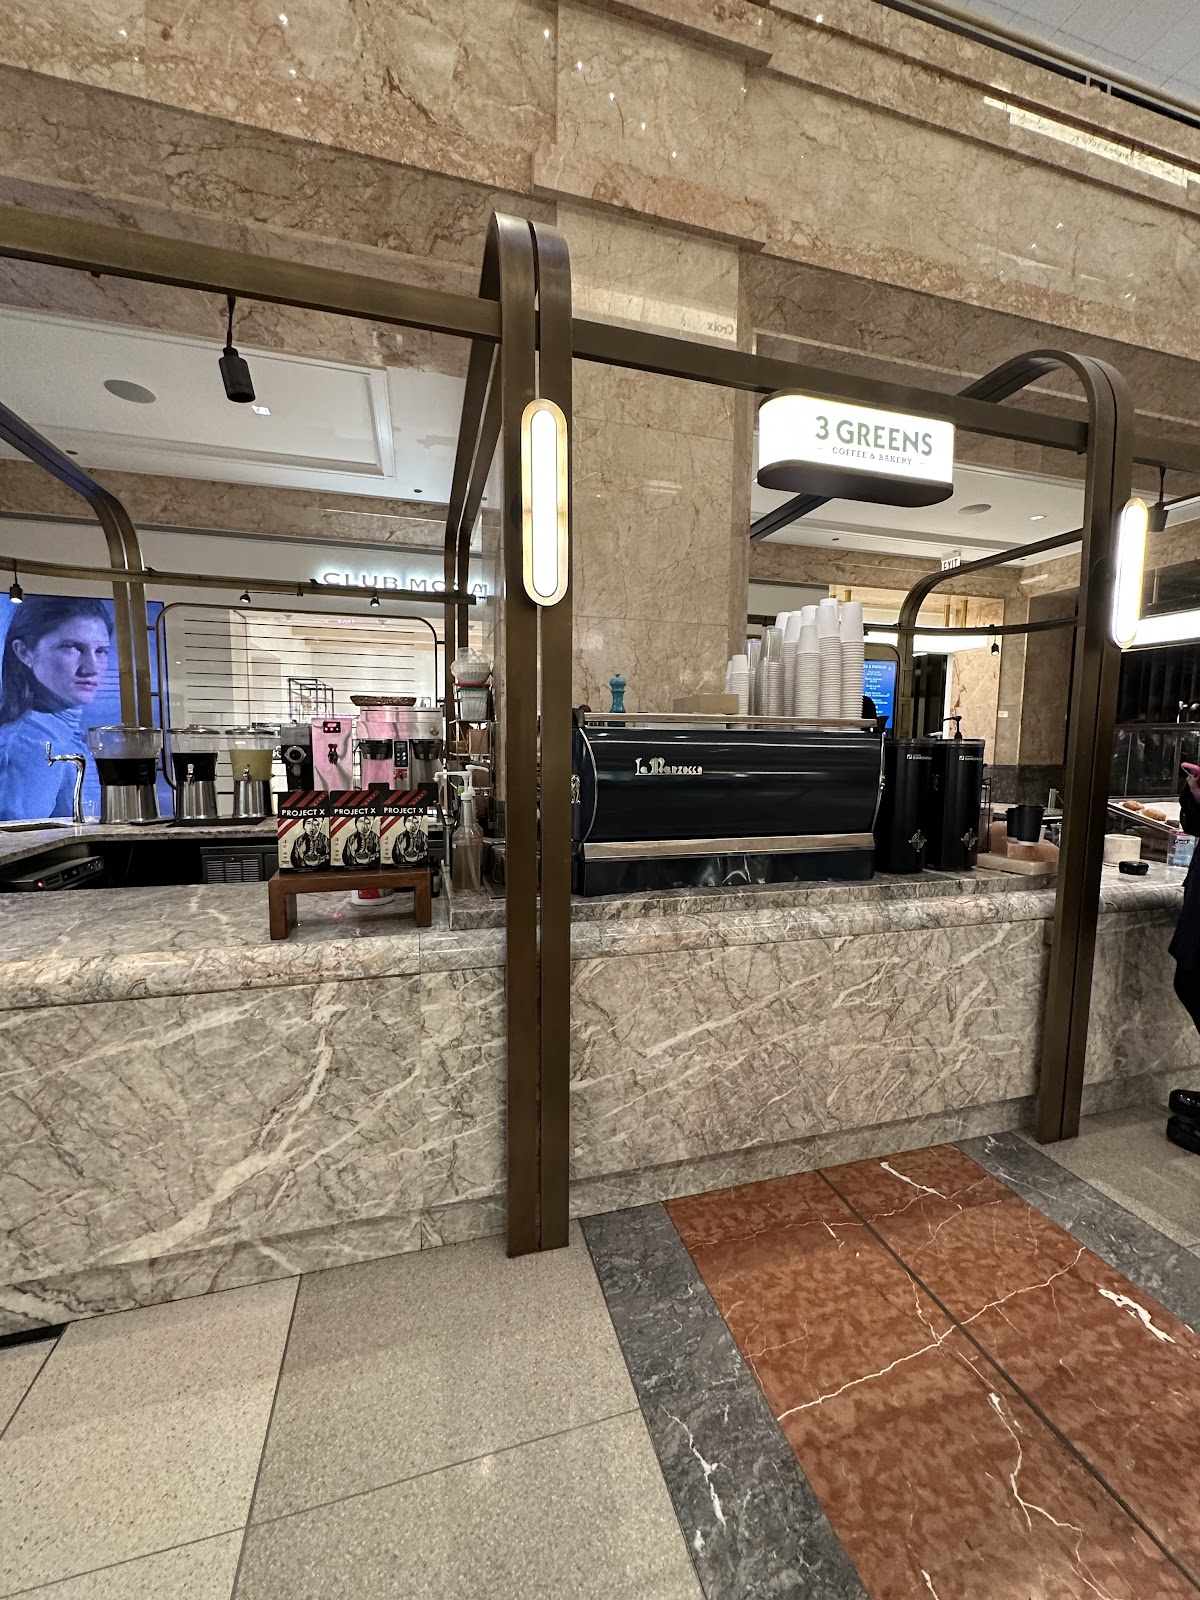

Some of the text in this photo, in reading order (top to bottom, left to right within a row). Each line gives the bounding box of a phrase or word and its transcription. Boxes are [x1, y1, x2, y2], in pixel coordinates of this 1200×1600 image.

[815, 415, 933, 456] 3 GREENS
[832, 446, 867, 459] COFFEE
[879, 453, 912, 465] BAKERY
[943, 559, 958, 570] EXIT
[323, 572, 398, 590] CLUB
[282, 808, 326, 817] PROJECT X
[334, 808, 367, 816] PROJECT
[383, 807, 416, 815] PROJECT
